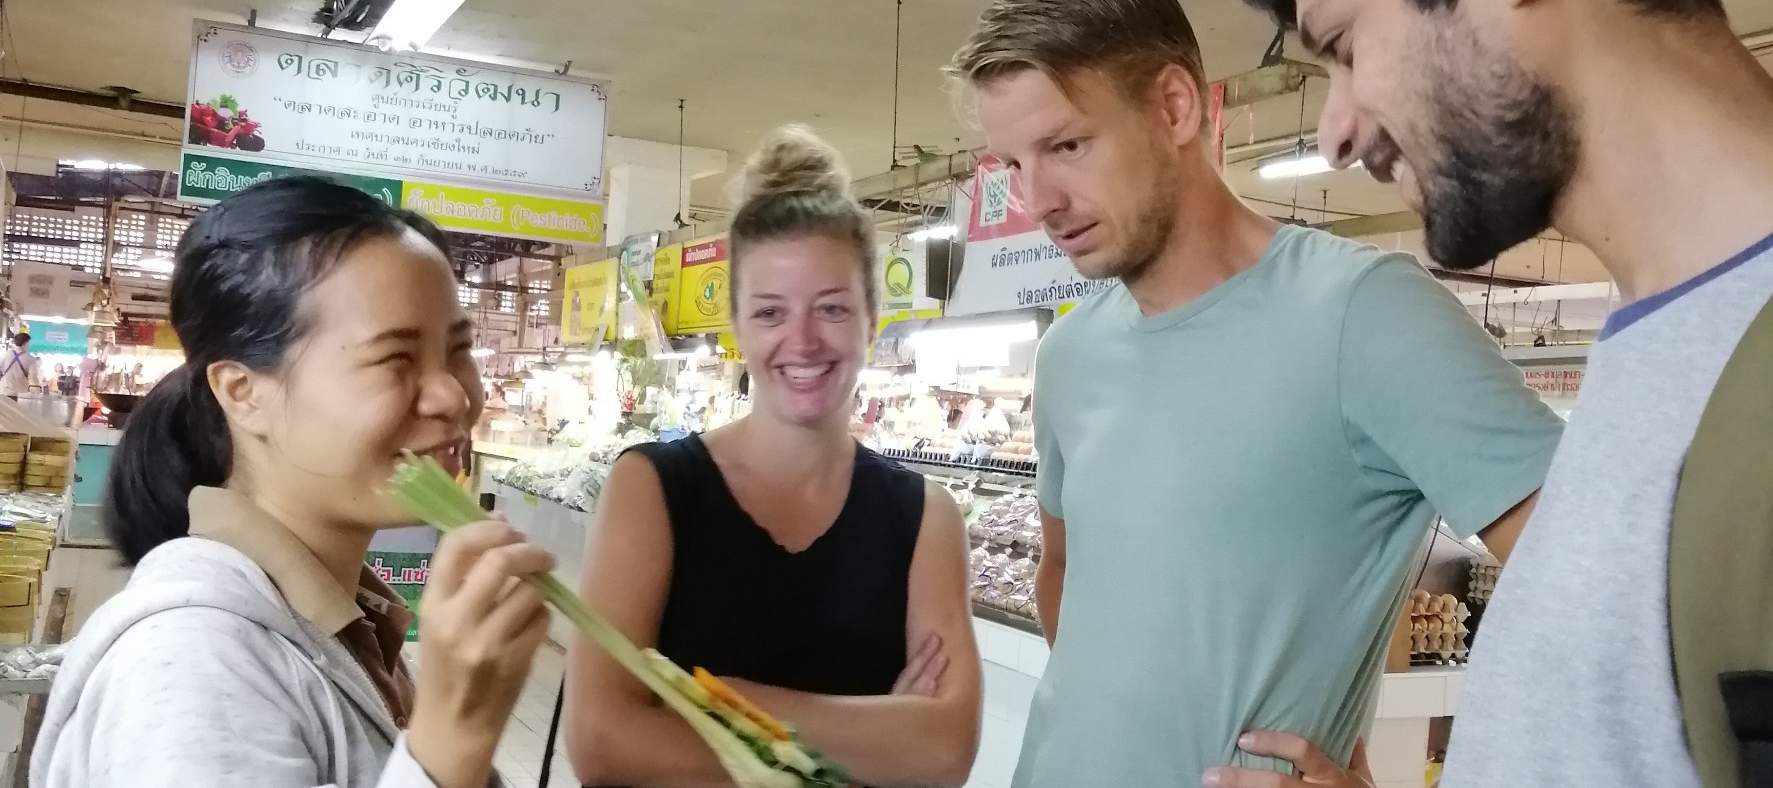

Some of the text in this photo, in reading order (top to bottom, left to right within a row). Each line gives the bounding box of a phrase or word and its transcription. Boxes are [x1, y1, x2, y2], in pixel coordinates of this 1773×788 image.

[350, 130, 481, 155] เทศบาลนครเชียงใหม่
[984, 208, 1003, 223] CPF
